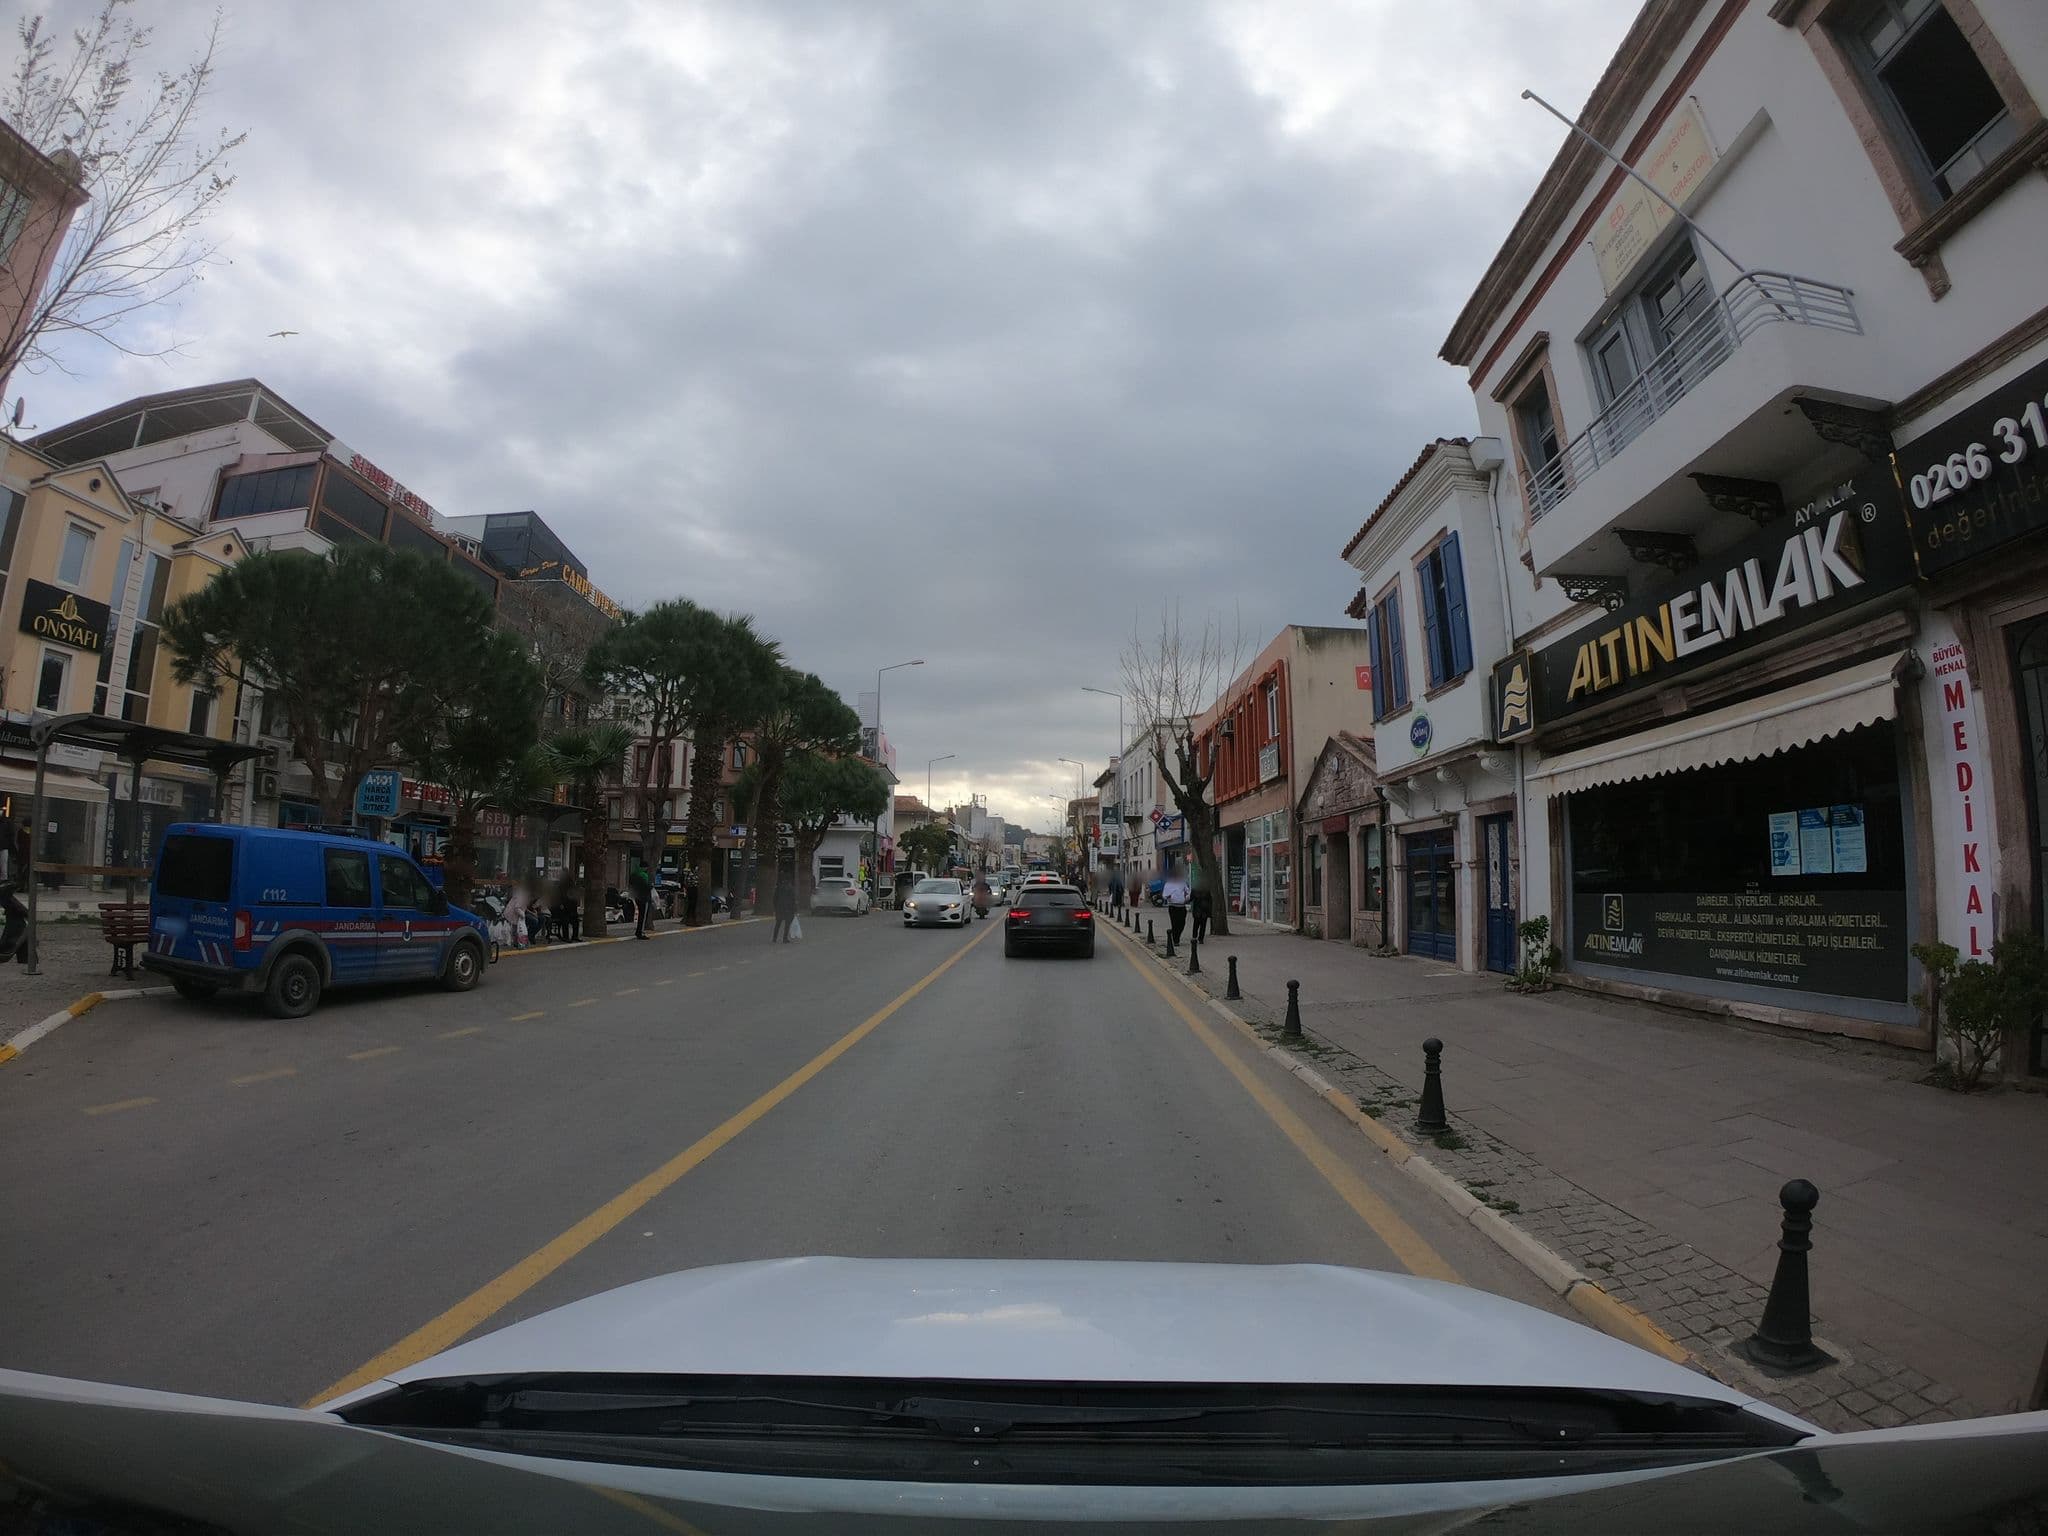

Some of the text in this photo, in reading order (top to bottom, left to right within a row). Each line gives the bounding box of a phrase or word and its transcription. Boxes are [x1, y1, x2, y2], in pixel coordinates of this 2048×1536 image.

[1910, 391, 2048, 509] 0266 31
[1566, 509, 1866, 704] ALTINEMLAK
[34, 615, 98, 649] ONSYAPI
[1932, 644, 1963, 663] BÜYÜK
[365, 785, 391, 794] HARCA
[364, 794, 390, 804] HARCA
[486, 813, 528, 825] SEDF
[1943, 680, 1982, 956] MEDİKAL
[270, 888, 287, 901] 112
[190, 913, 228, 926] JANDARMA
[334, 921, 376, 931] JANDARMA
[1775, 917, 1784, 926] ve
[1807, 934, 1829, 947] TAPU
[1716, 965, 1800, 984] www.altinemlak.com.tr
